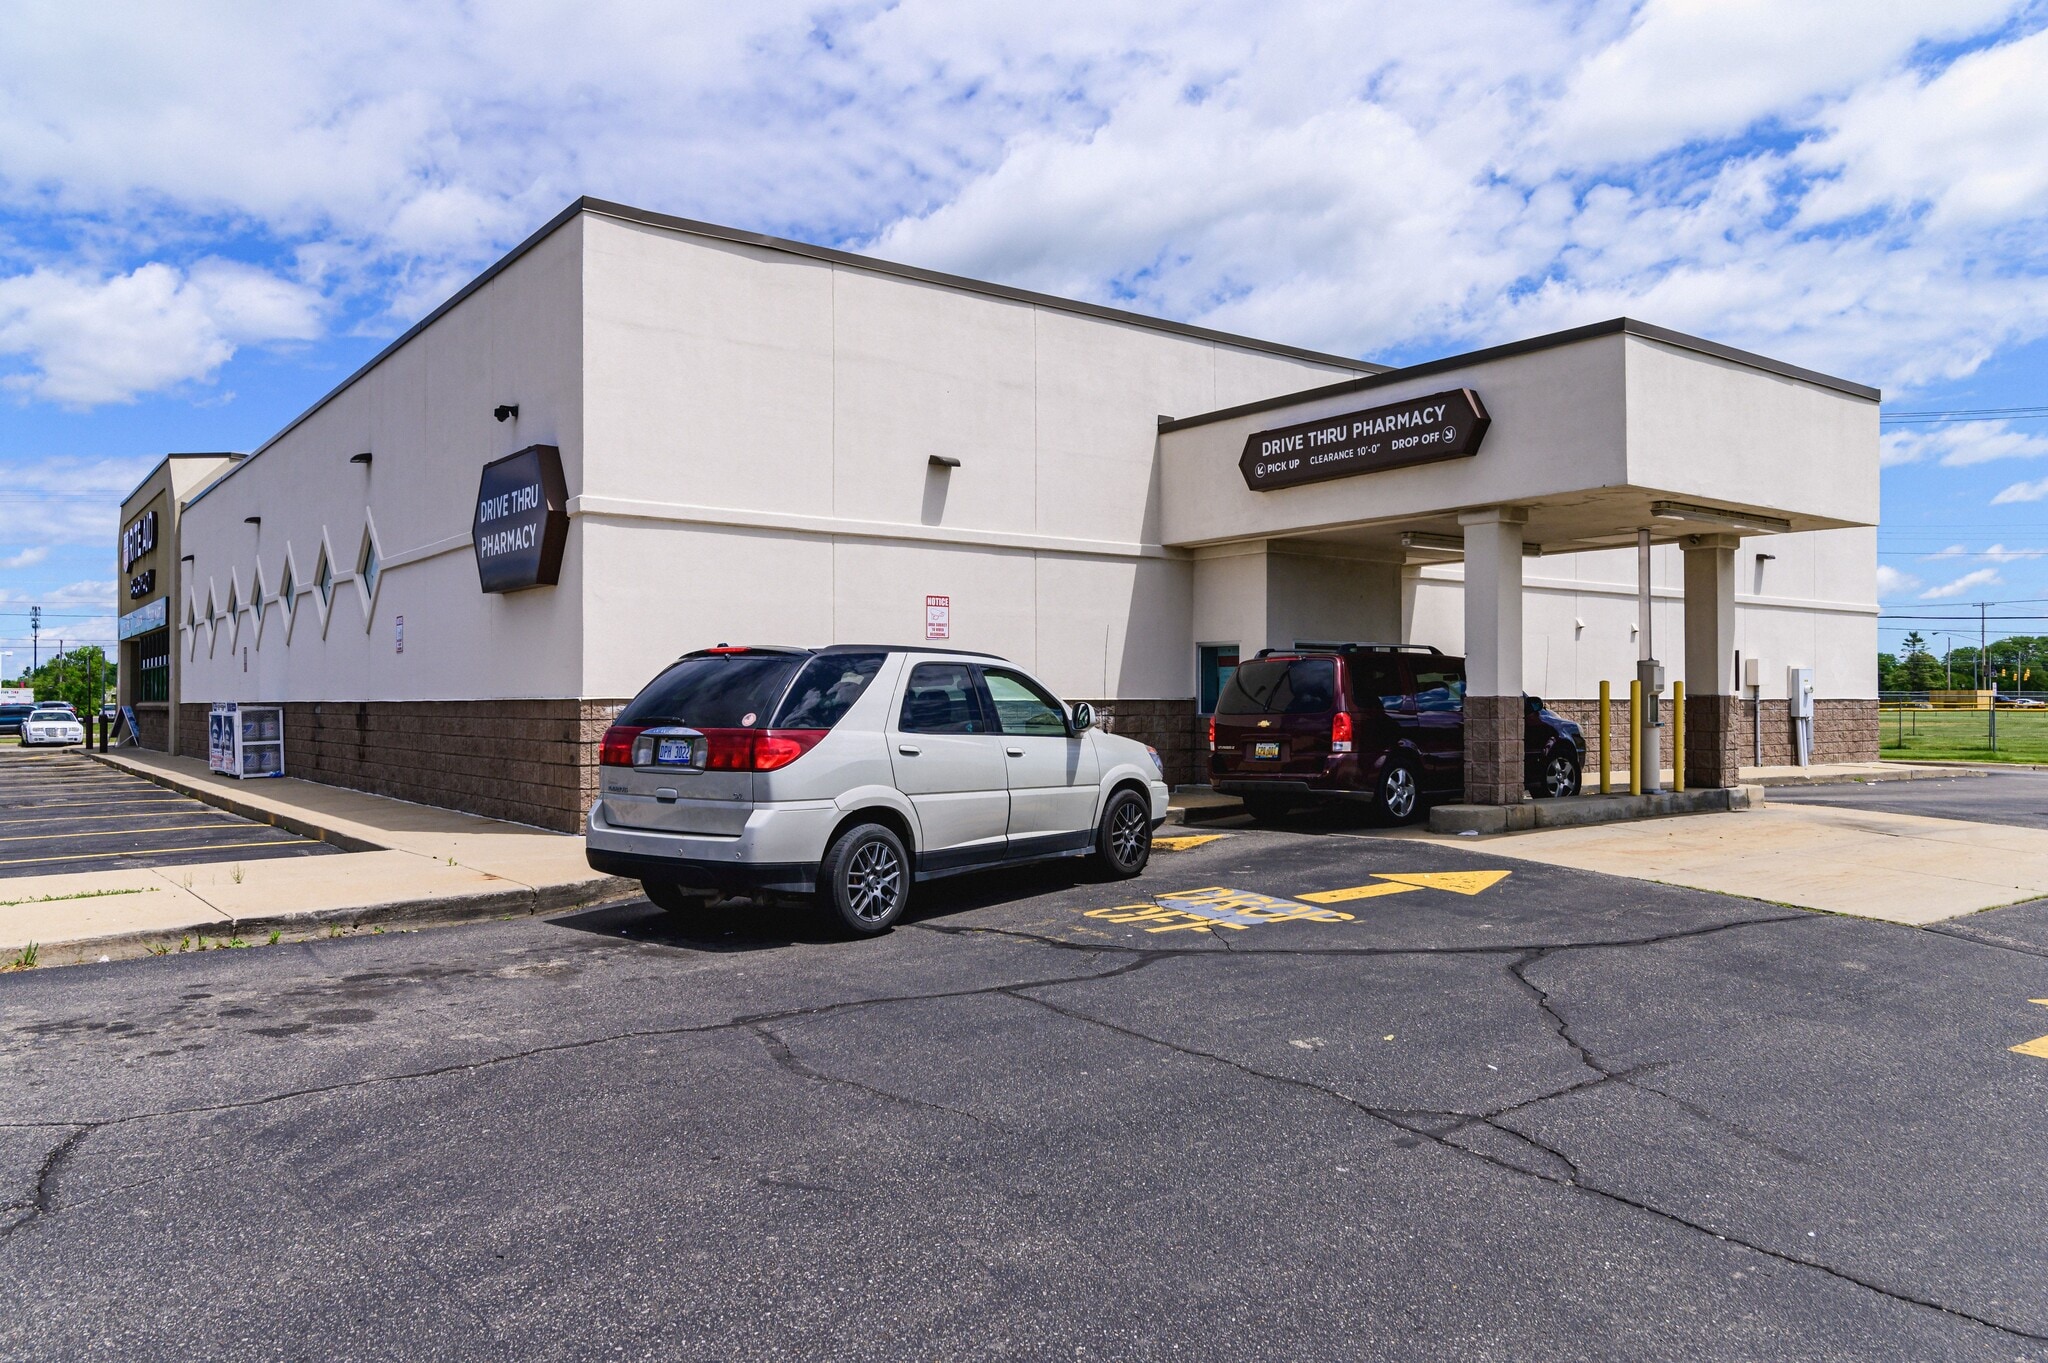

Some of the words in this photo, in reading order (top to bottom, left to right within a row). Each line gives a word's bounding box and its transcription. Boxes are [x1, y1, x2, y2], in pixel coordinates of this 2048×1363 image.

[1262, 434, 1304, 457] DRIVE
[1307, 425, 1347, 447] THRU
[1353, 404, 1446, 439] PHARMACY
[1391, 436, 1419, 451] DROP
[1421, 431, 1440, 445] OFF
[1310, 448, 1354, 465] CLEARANCE
[1267, 462, 1287, 474] PICK
[1288, 459, 1300, 469] UP
[481, 493, 508, 523] DRIVE
[511, 484, 539, 513] THRU
[481, 523, 537, 559] PHARMACY
[927, 596, 949, 606] NOTICE
[674, 745, 690, 759] 3022
